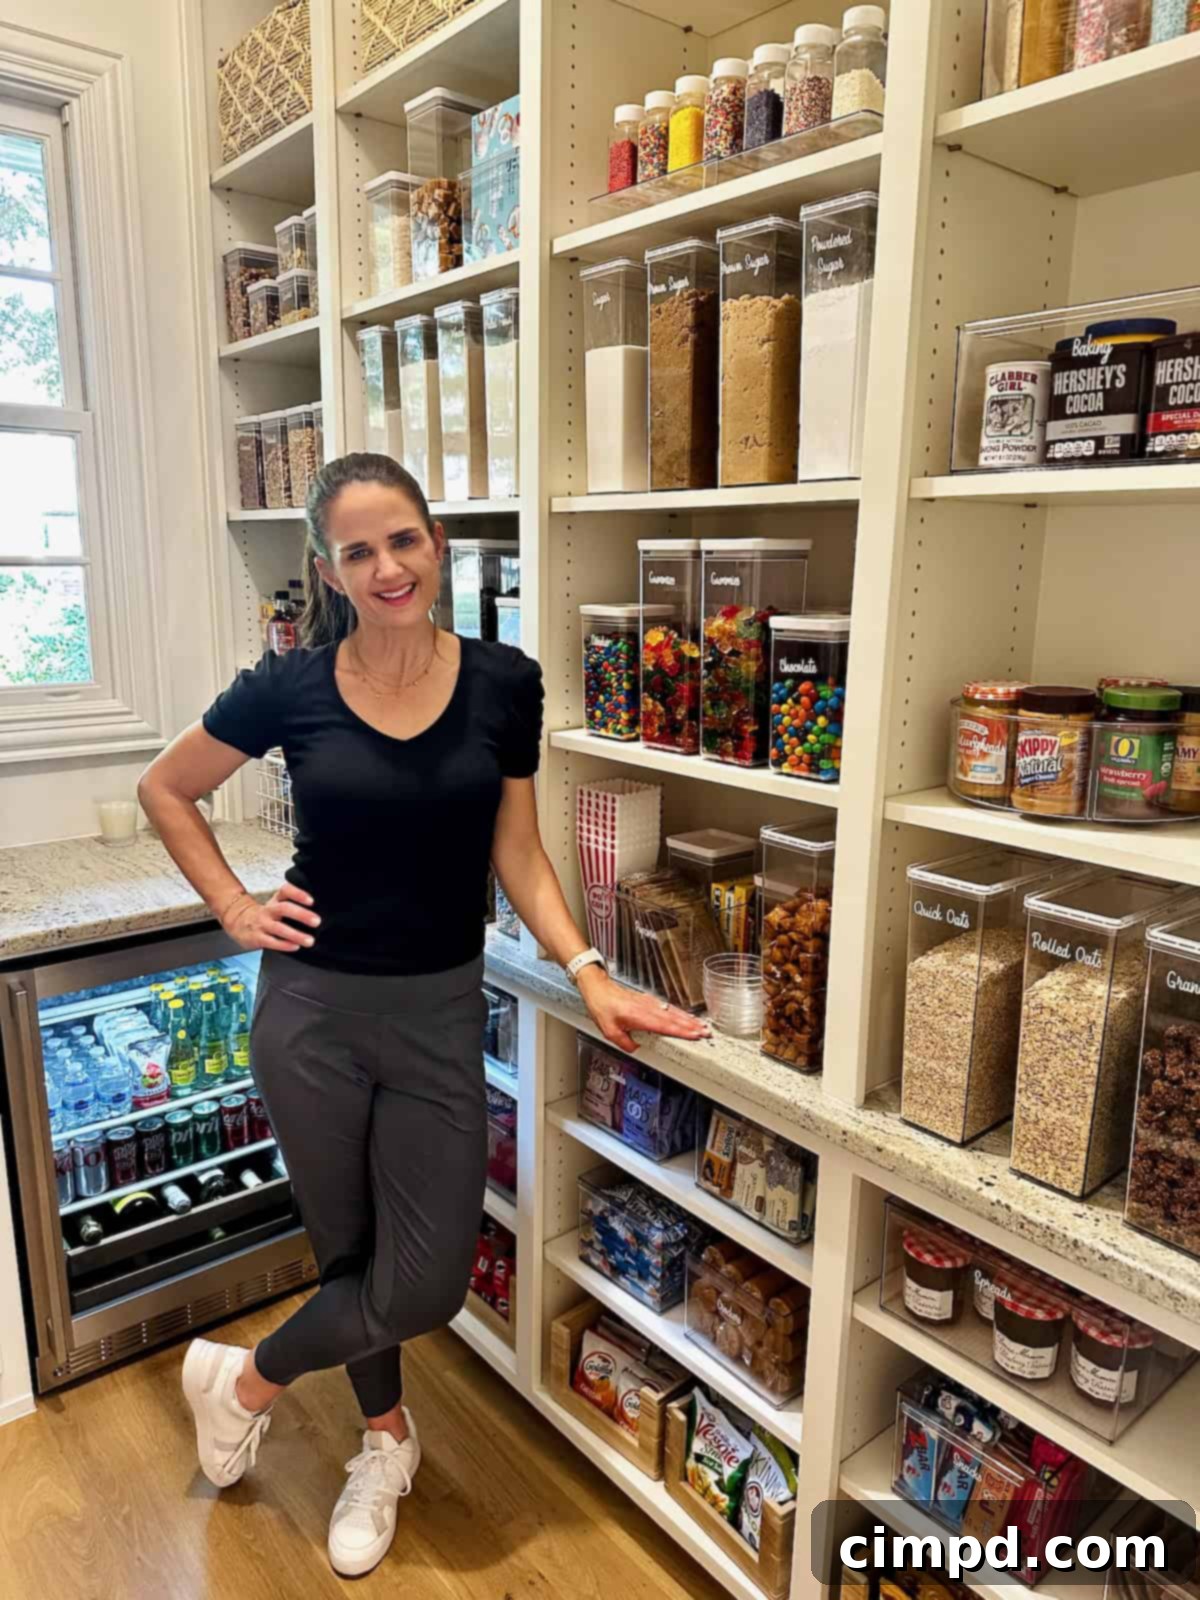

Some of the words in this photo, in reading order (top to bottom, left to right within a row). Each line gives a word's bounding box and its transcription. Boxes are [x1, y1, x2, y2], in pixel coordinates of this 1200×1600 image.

[811, 227, 853, 253] Powdered
[744, 253, 770, 277] Sugar
[817, 256, 844, 280] Sugar
[1072, 334, 1113, 365] Baking
[989, 371, 1038, 387] CLABBER
[997, 381, 1023, 393] GIRL
[1054, 363, 1127, 395] HERSHEY'S
[1065, 391, 1104, 415] COCOA
[1017, 737, 1058, 758] SKIPPY
[913, 900, 943, 921] Quick
[946, 909, 970, 929] Oats
[1031, 931, 1071, 959] Rolled
[1075, 946, 1102, 969] Oats
[975, 1269, 1013, 1301] Spreads
